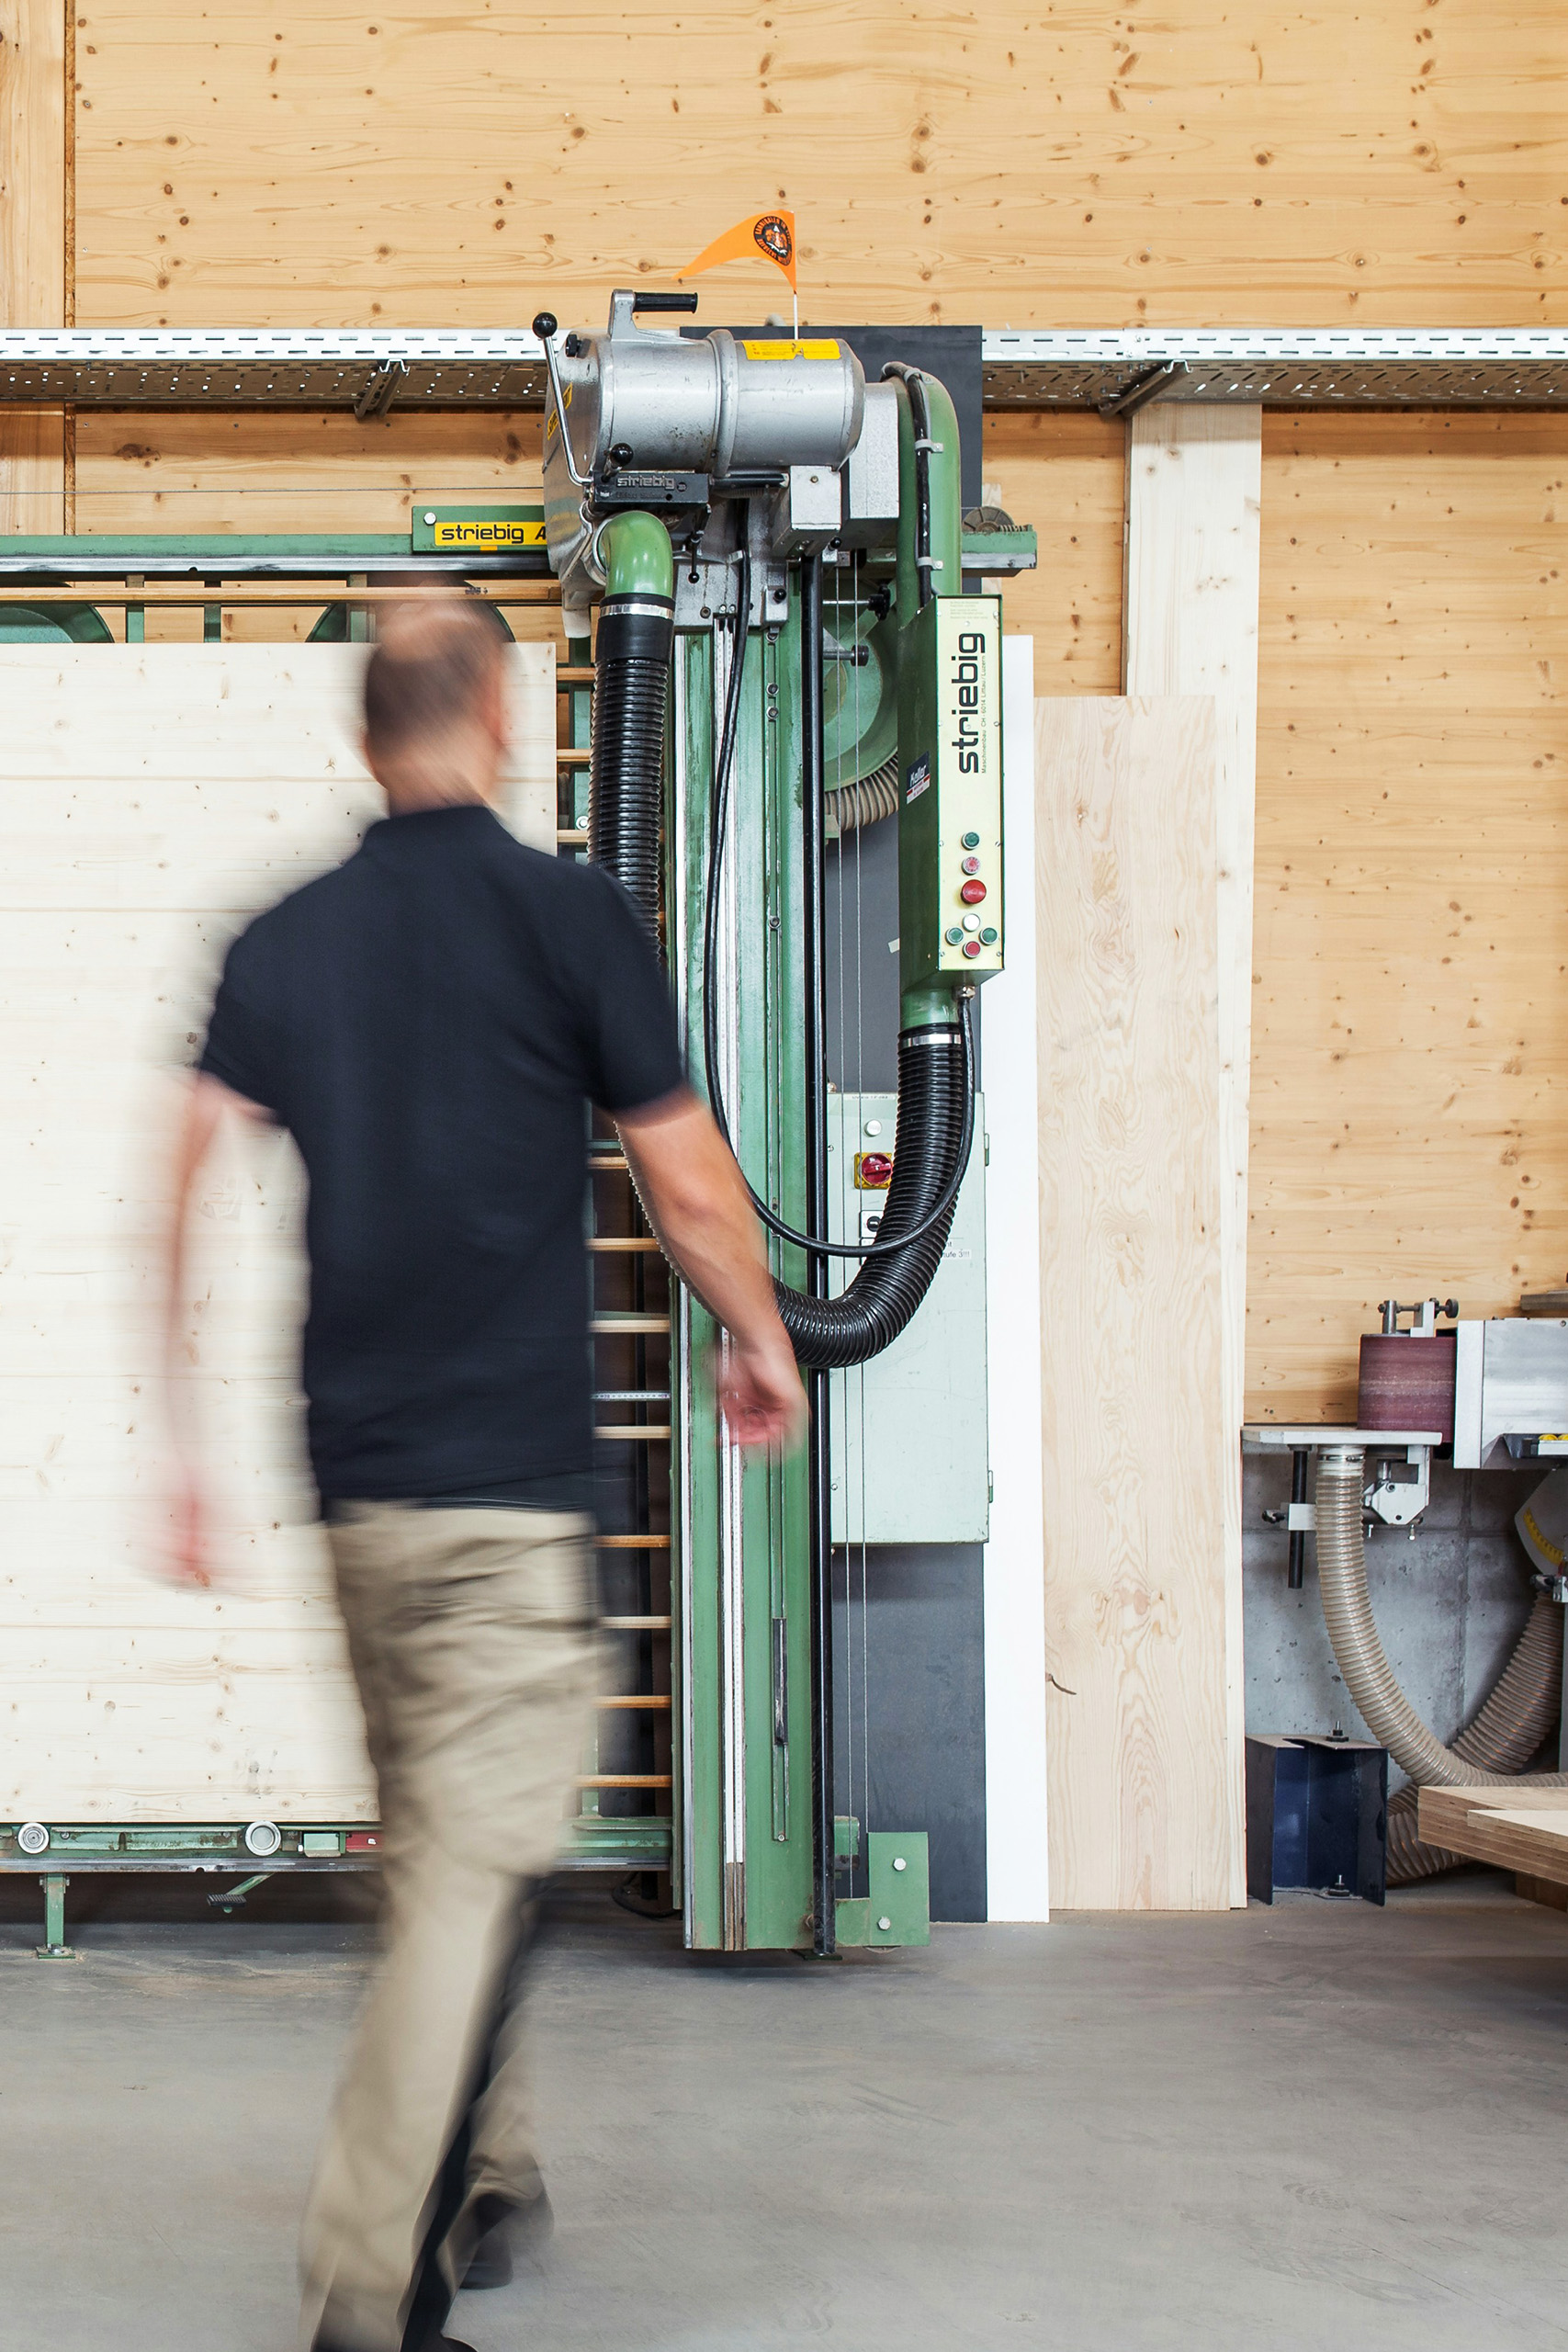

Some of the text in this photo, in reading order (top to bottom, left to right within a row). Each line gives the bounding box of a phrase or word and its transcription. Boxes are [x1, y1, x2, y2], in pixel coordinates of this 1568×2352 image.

[616, 474, 676, 491] striebig
[442, 524, 525, 544] striebig
[952, 633, 986, 774] striebig
